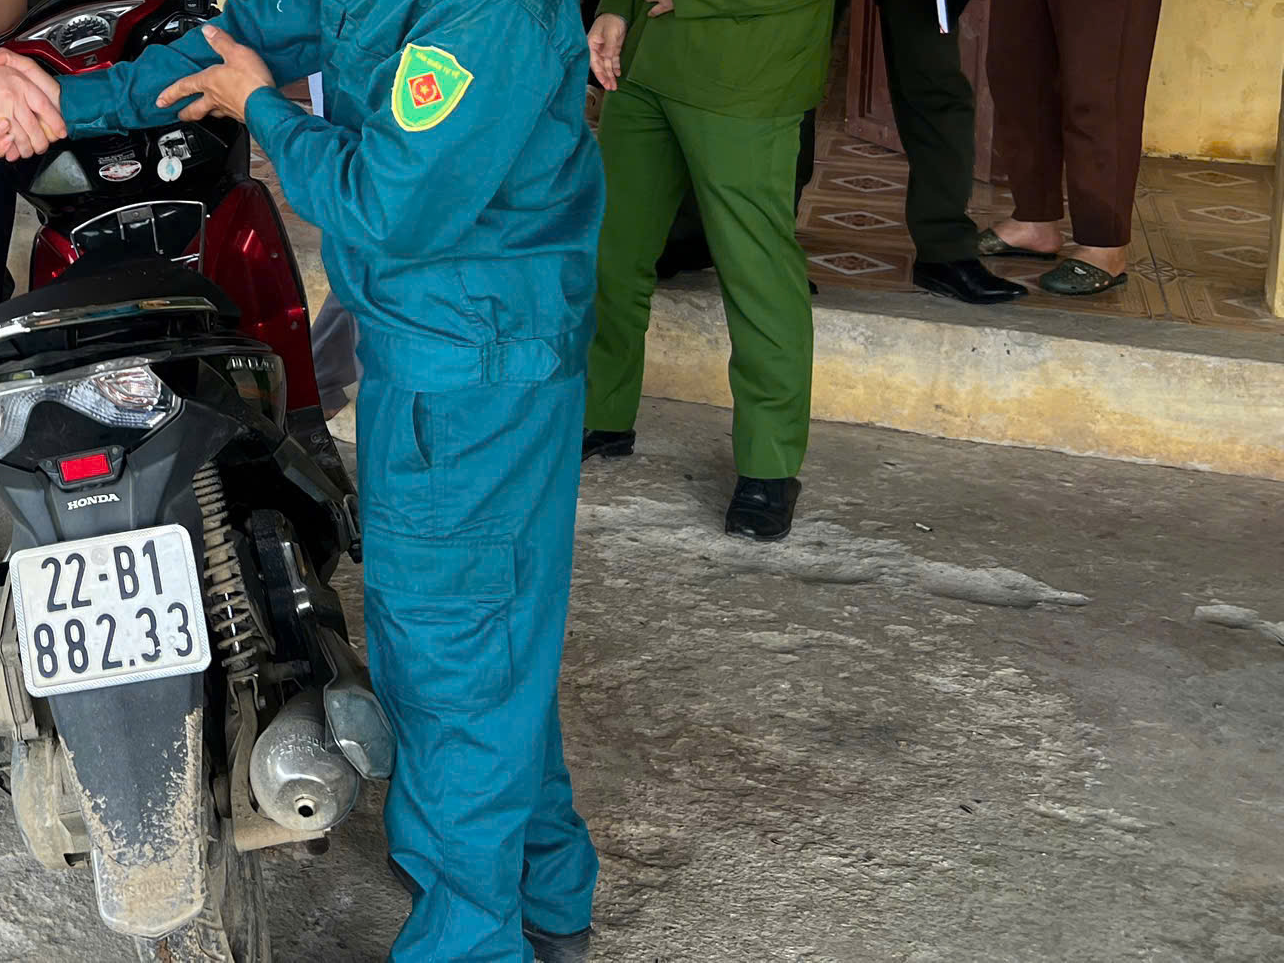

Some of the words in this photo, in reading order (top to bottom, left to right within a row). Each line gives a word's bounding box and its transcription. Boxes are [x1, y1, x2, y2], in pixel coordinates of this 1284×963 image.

[67, 493, 120, 511] HONDA
[41, 539, 163, 613] 22-B1
[33, 601, 193, 678] 882.33
